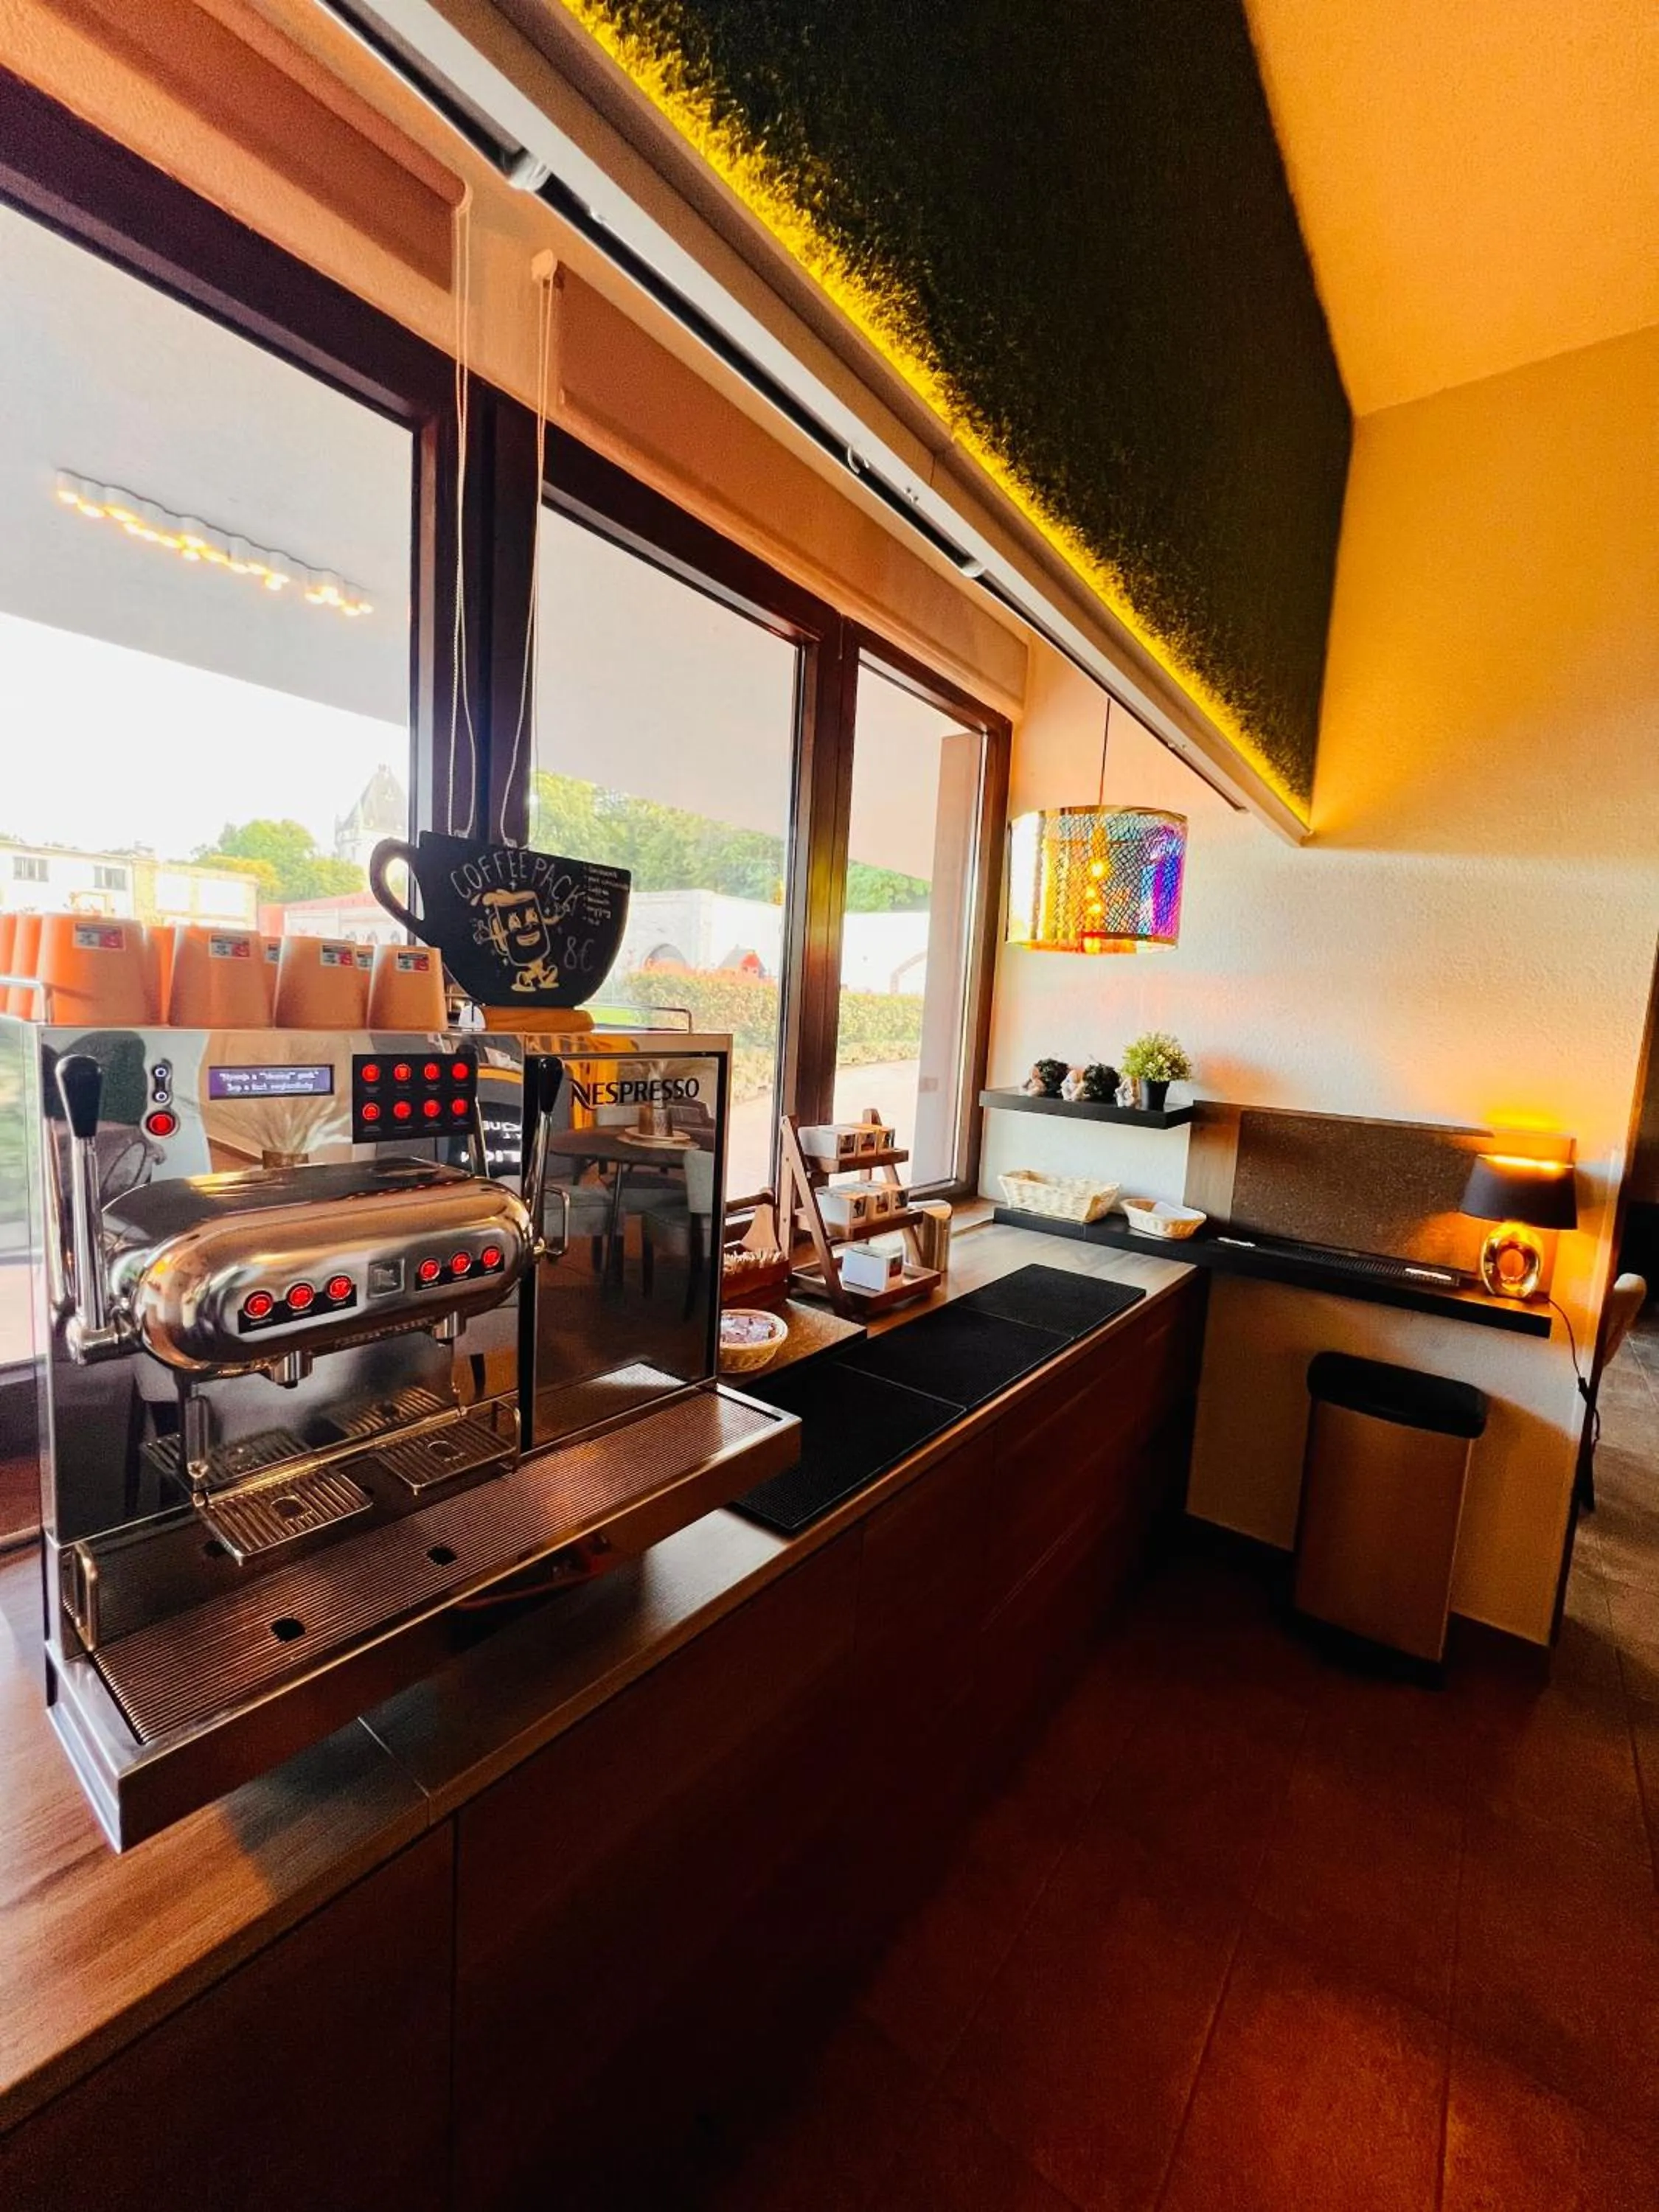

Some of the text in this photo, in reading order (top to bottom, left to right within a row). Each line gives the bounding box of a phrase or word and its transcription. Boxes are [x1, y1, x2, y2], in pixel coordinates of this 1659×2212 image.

[451, 851, 586, 916] COFFEE PACK
[566, 1077, 699, 1110] NESPRESSO
